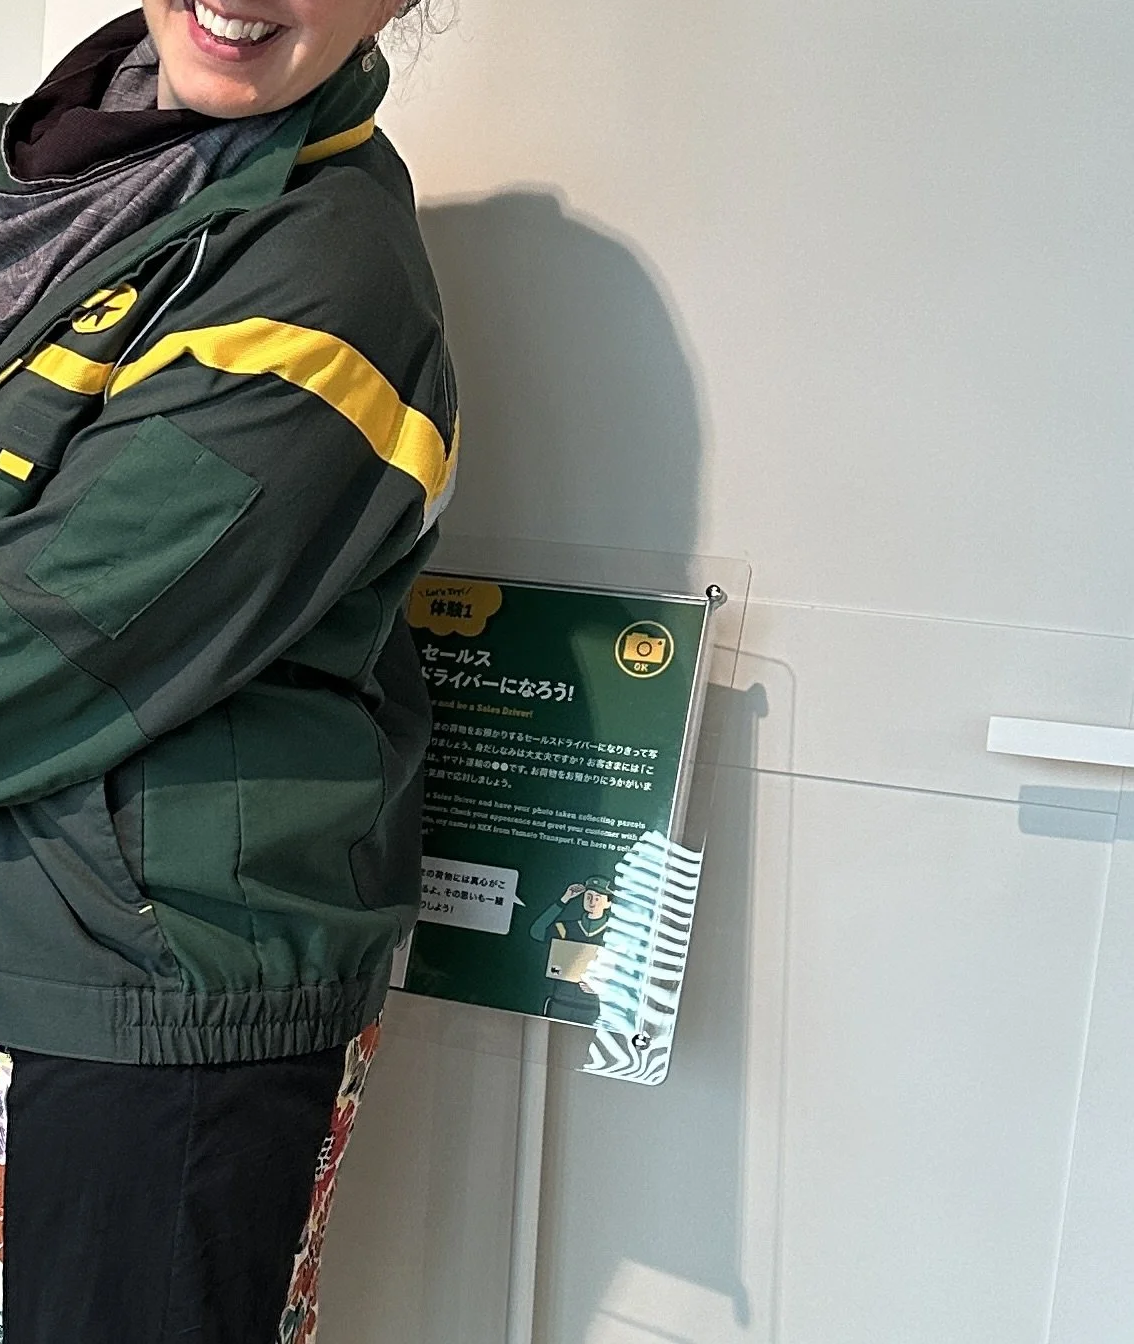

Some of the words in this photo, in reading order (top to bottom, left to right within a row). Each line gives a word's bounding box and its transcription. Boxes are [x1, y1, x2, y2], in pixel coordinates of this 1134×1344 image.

[426, 587, 446, 597] Let's
[430, 599, 473, 619] 体験1
[421, 644, 491, 667] セールス
[634, 662, 648, 672] OK
[438, 700, 455, 709] and
[477, 703, 500, 714] Sales
[502, 706, 533, 718] Driver!
[432, 791, 452, 801] Sales
[454, 794, 476, 805] Driver
[478, 799, 492, 807] and
[494, 800, 512, 810] have
[532, 806, 554, 815] photo
[555, 809, 577, 820] taken
[578, 813, 616, 826] collecting
[617, 819, 646, 829] parcels
[450, 807, 471, 816] Check
[490, 814, 531, 825] appearance
[532, 819, 546, 828] and
[547, 821, 566, 830] greet
[567, 825, 583, 833] your
[585, 827, 619, 838] customer
[621, 832, 638, 841] with
[493, 825, 511, 834] from
[511, 828, 538, 839] Yamato
[590, 840, 607, 850] here
[608, 843, 616, 851] to
